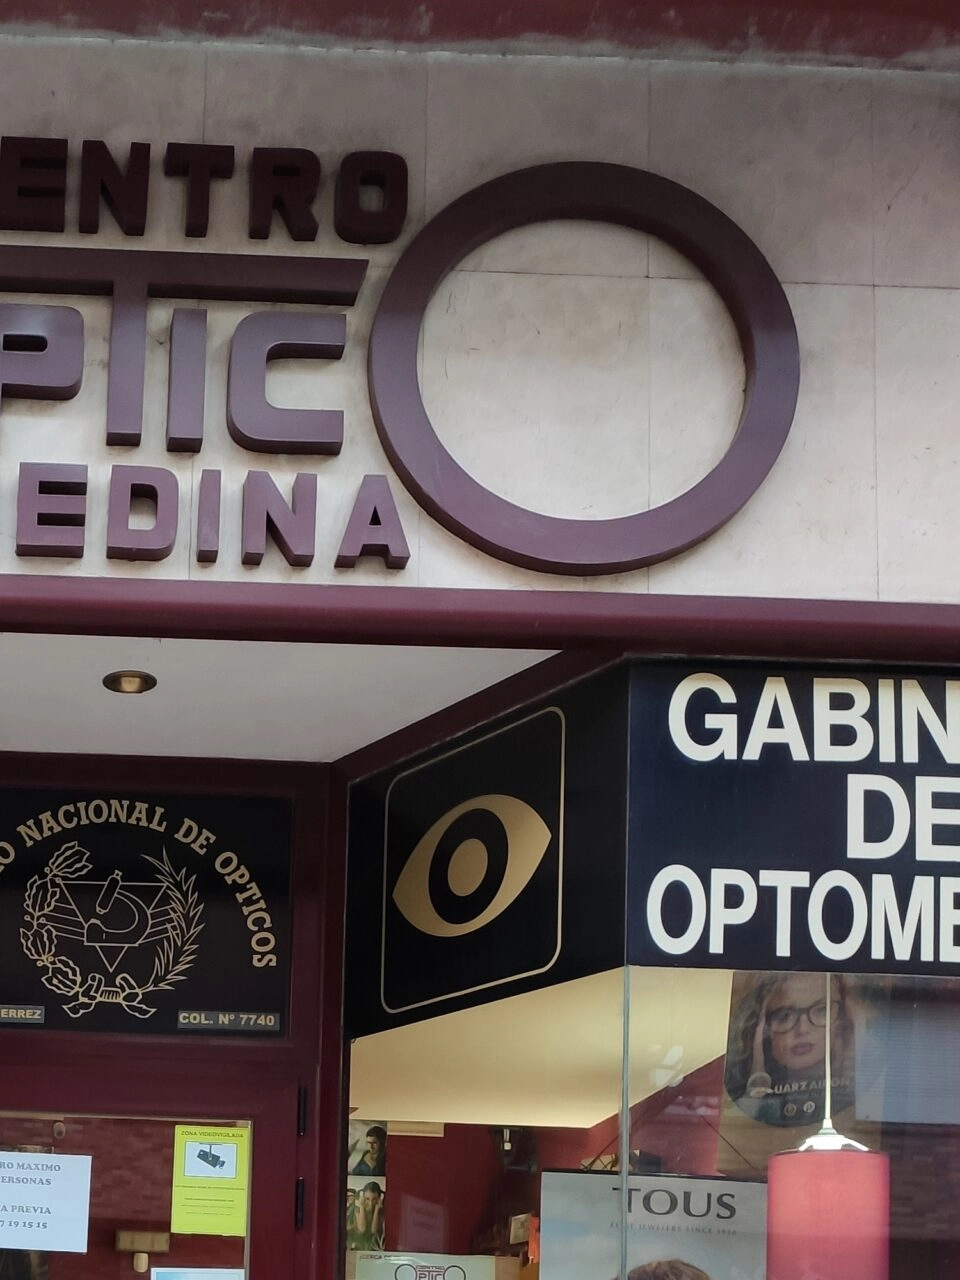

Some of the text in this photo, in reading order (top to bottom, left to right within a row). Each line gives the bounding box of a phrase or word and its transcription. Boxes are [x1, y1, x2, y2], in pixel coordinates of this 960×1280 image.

[846, 773, 960, 862] DE
[16, 799, 167, 848] NACIONAL
[174, 818, 216, 855] DE
[214, 851, 277, 968] OPTICOS
[179, 1012, 214, 1024] COL.
[239, 1014, 275, 1026] 7740
[16, 1161, 61, 1172] MAXIMO
[11, 1205, 52, 1215] PREVIA
[612, 1187, 737, 1220] TOUS
[22, 1221, 33, 1229] 15
